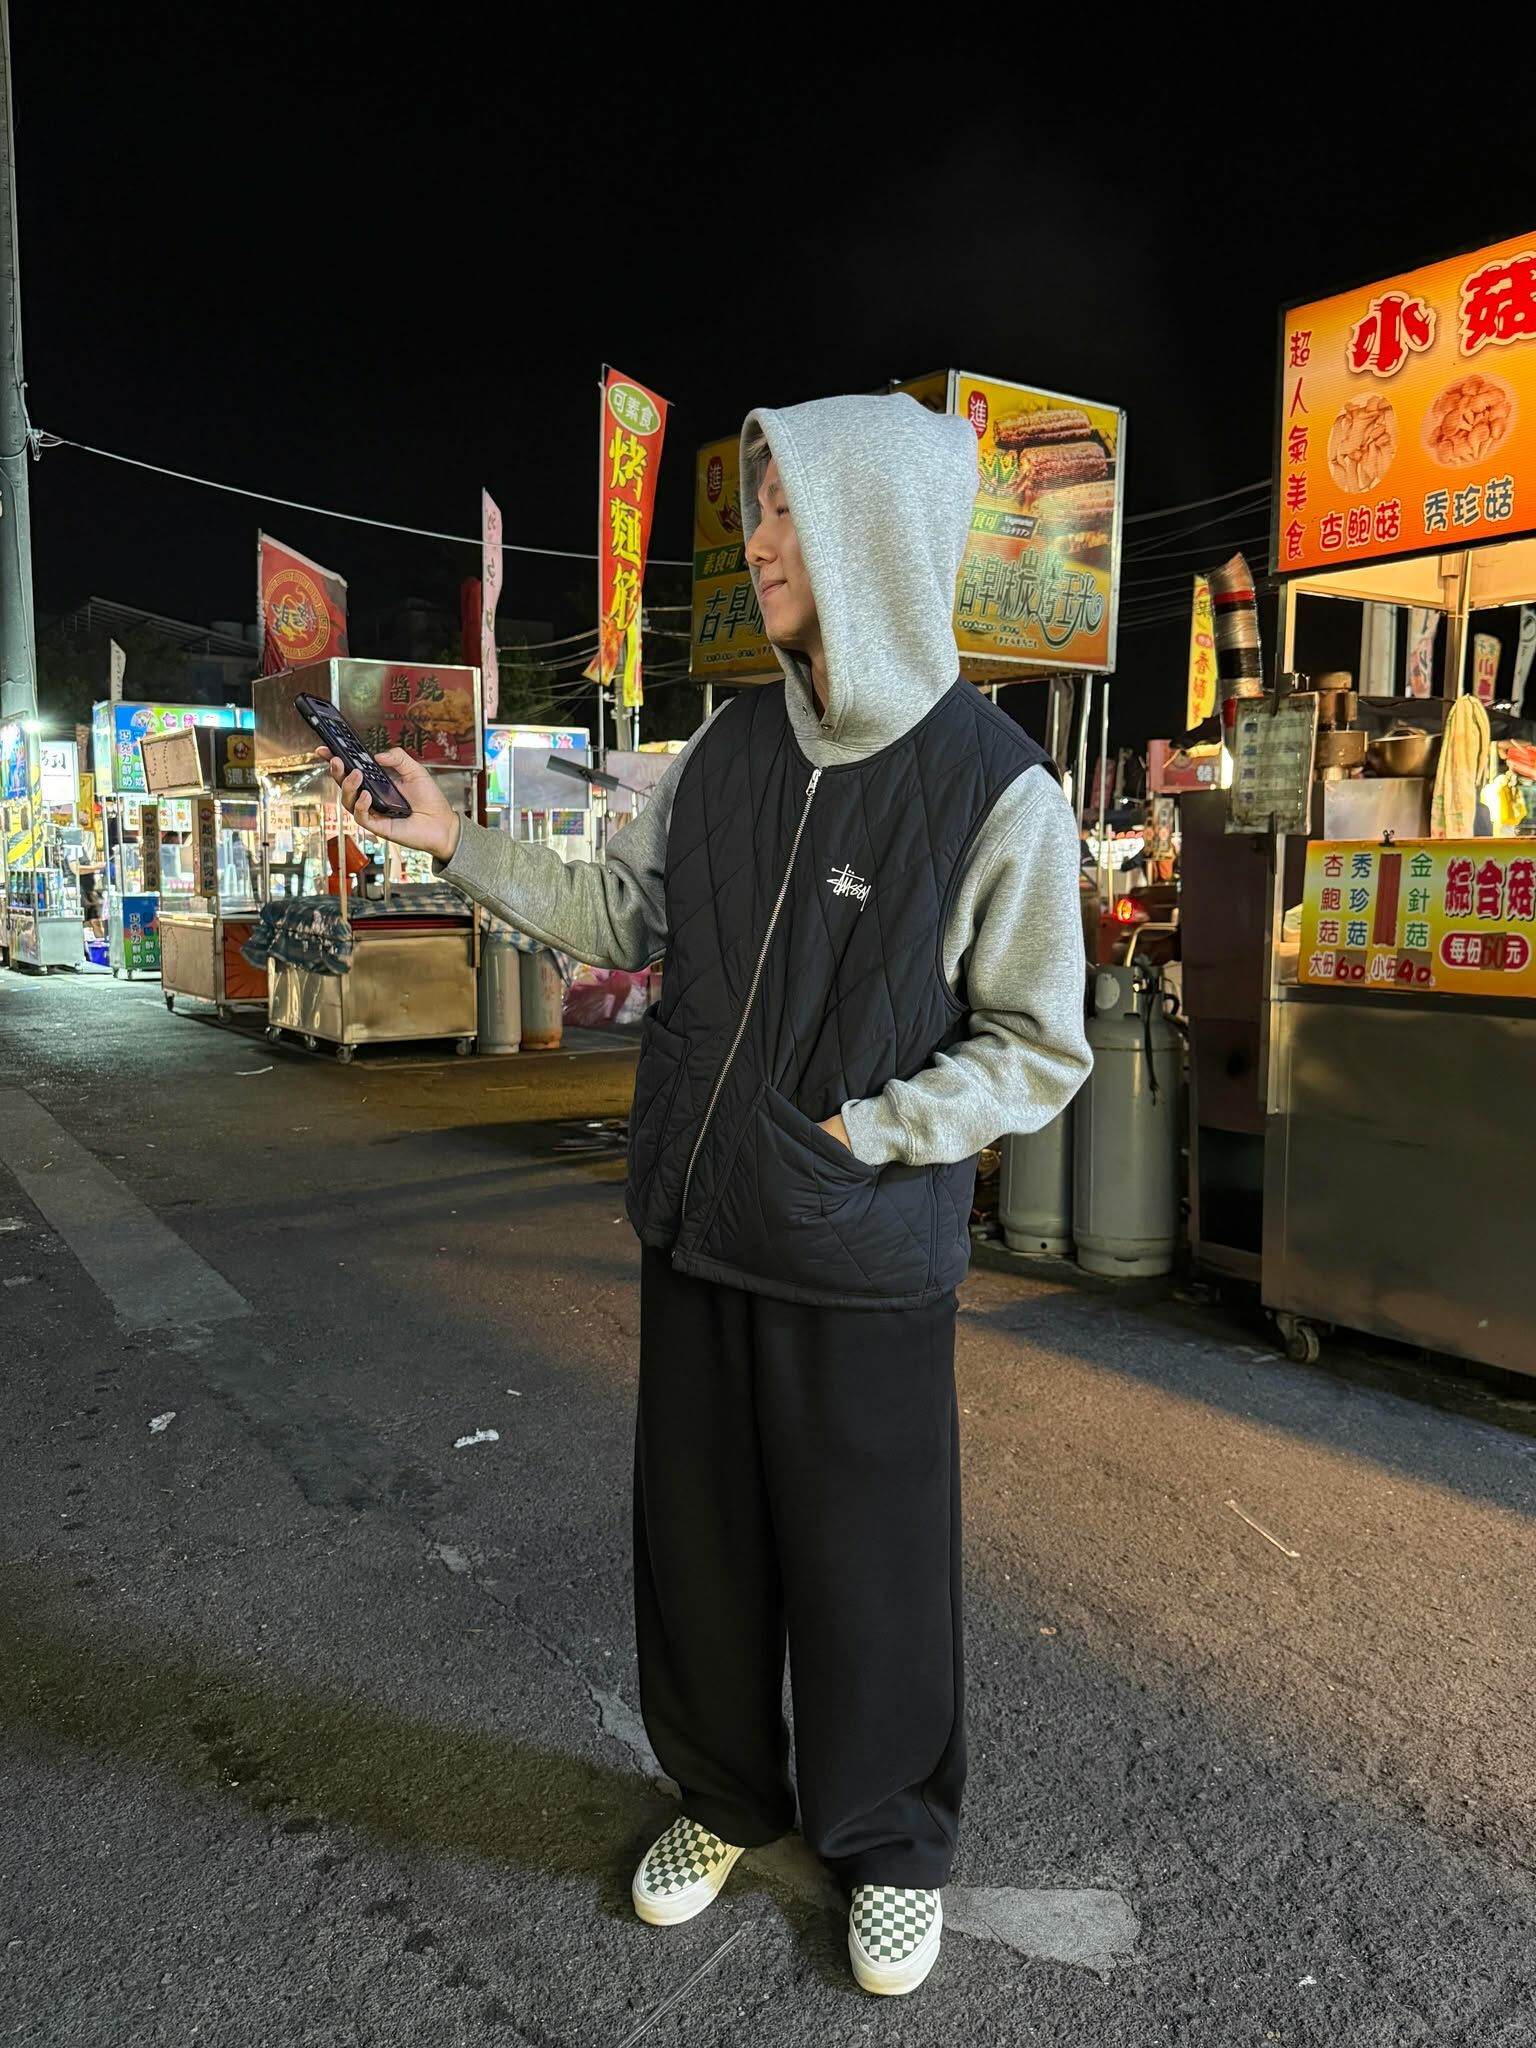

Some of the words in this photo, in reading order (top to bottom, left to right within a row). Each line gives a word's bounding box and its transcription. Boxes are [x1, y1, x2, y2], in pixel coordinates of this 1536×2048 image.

[612, 388, 654, 432] 可素食
[1286, 329, 1313, 561] 超人氣美食
[608, 425, 648, 632] 烤麵筋
[1319, 496, 1402, 552] 杏鮑菇
[1423, 473, 1516, 534] 秀珍菇
[1318, 854, 1345, 946] 杏鮑菇
[1346, 853, 1374, 947] 秀珍菇
[1405, 853, 1434, 949] 金針菇
[1444, 857, 1535, 920] 綜合菇
